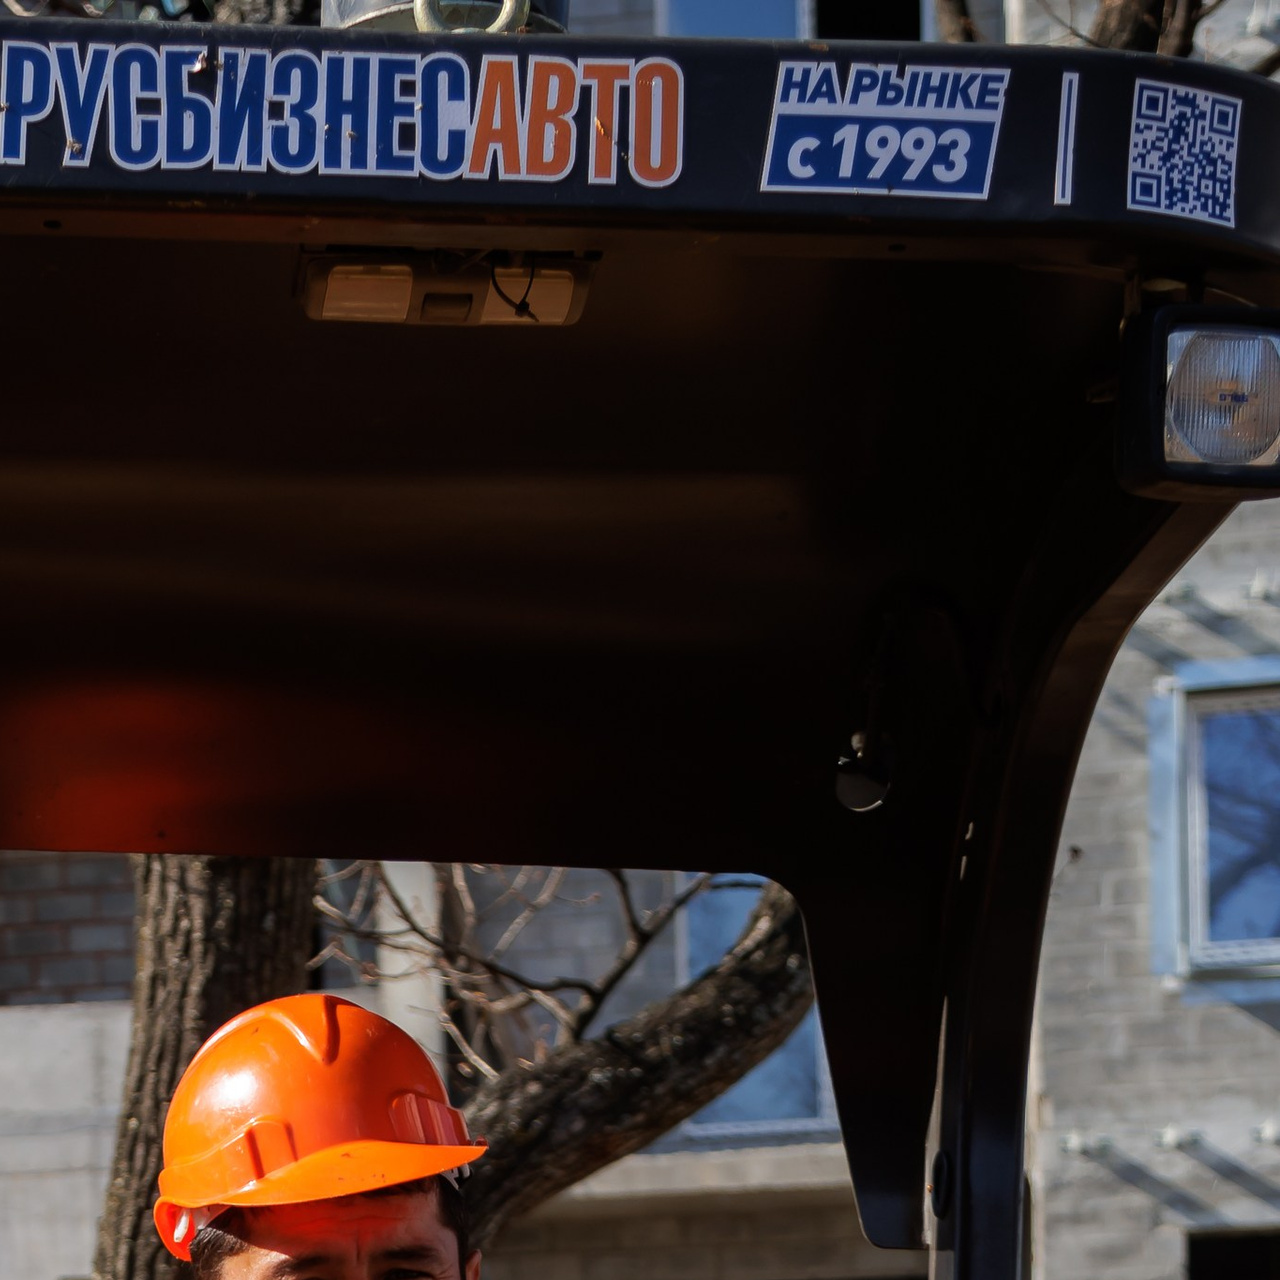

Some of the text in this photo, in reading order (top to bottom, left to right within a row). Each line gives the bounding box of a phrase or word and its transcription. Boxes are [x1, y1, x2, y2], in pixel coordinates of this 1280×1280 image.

[0, 40, 685, 187] РУСБИЗНЕСАВТО
[780, 67, 1006, 111] НА РЫНКЕ
[787, 124, 971, 183] с 1993
